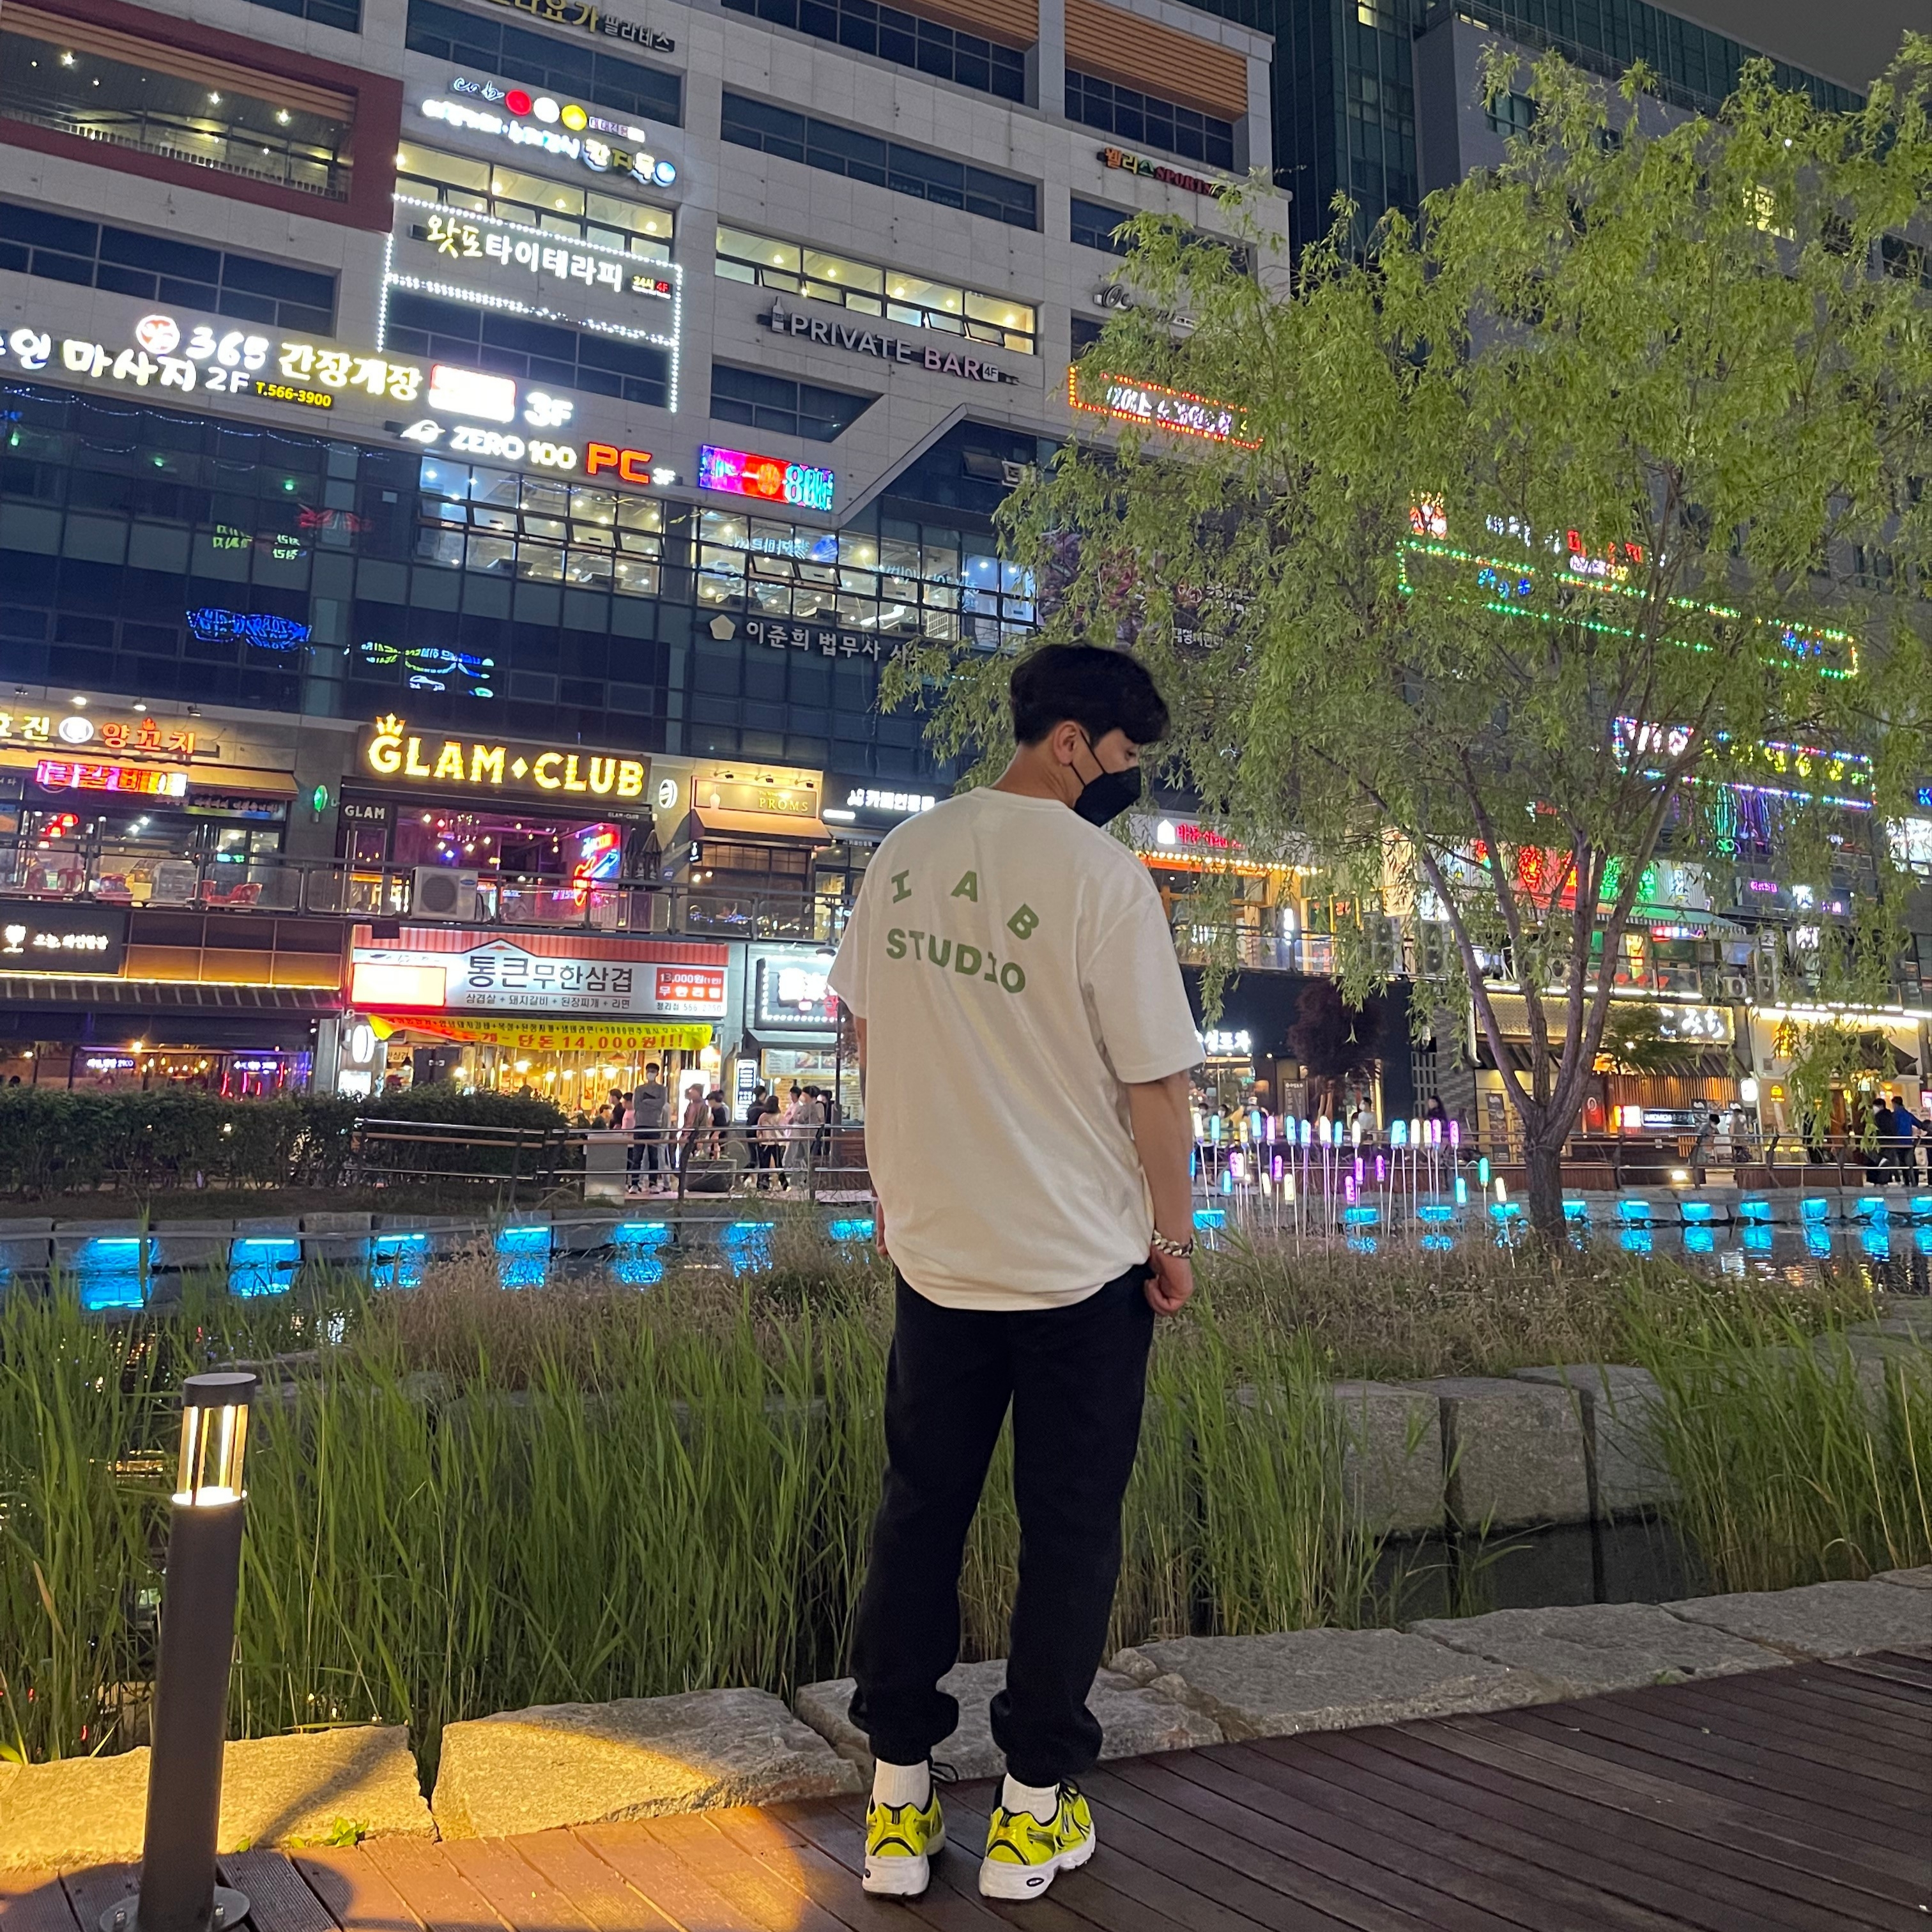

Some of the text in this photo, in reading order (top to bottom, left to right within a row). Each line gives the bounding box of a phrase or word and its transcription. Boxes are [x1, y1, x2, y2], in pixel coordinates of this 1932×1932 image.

[604, 14, 670, 52] 필라테스
[186, 326, 270, 371] 365
[790, 312, 999, 381] PRIVATE BAR 4F
[63, 339, 197, 392] 마사지
[205, 367, 251, 394] 2F
[256, 382, 332, 408] T.566-3900
[523, 392, 574, 427] 3F
[450, 425, 525, 461] ZERO
[528, 440, 578, 470] 100
[586, 442, 652, 484] PC
[653, 467, 676, 485] 3F
[746, 621, 809, 651] 이준희
[818, 632, 881, 662] 법무사
[102, 718, 195, 755] 양꼬치
[368, 733, 645, 798] GLAM CLUB
[344, 804, 385, 820] GLAM
[758, 797, 809, 813] PROMS
[886, 928, 1026, 993] STUDIO
[466, 993, 496, 1005] 삼겹살
[509, 994, 548, 1006] 돼지갈비
[561, 997, 599, 1008] 된장찌개
